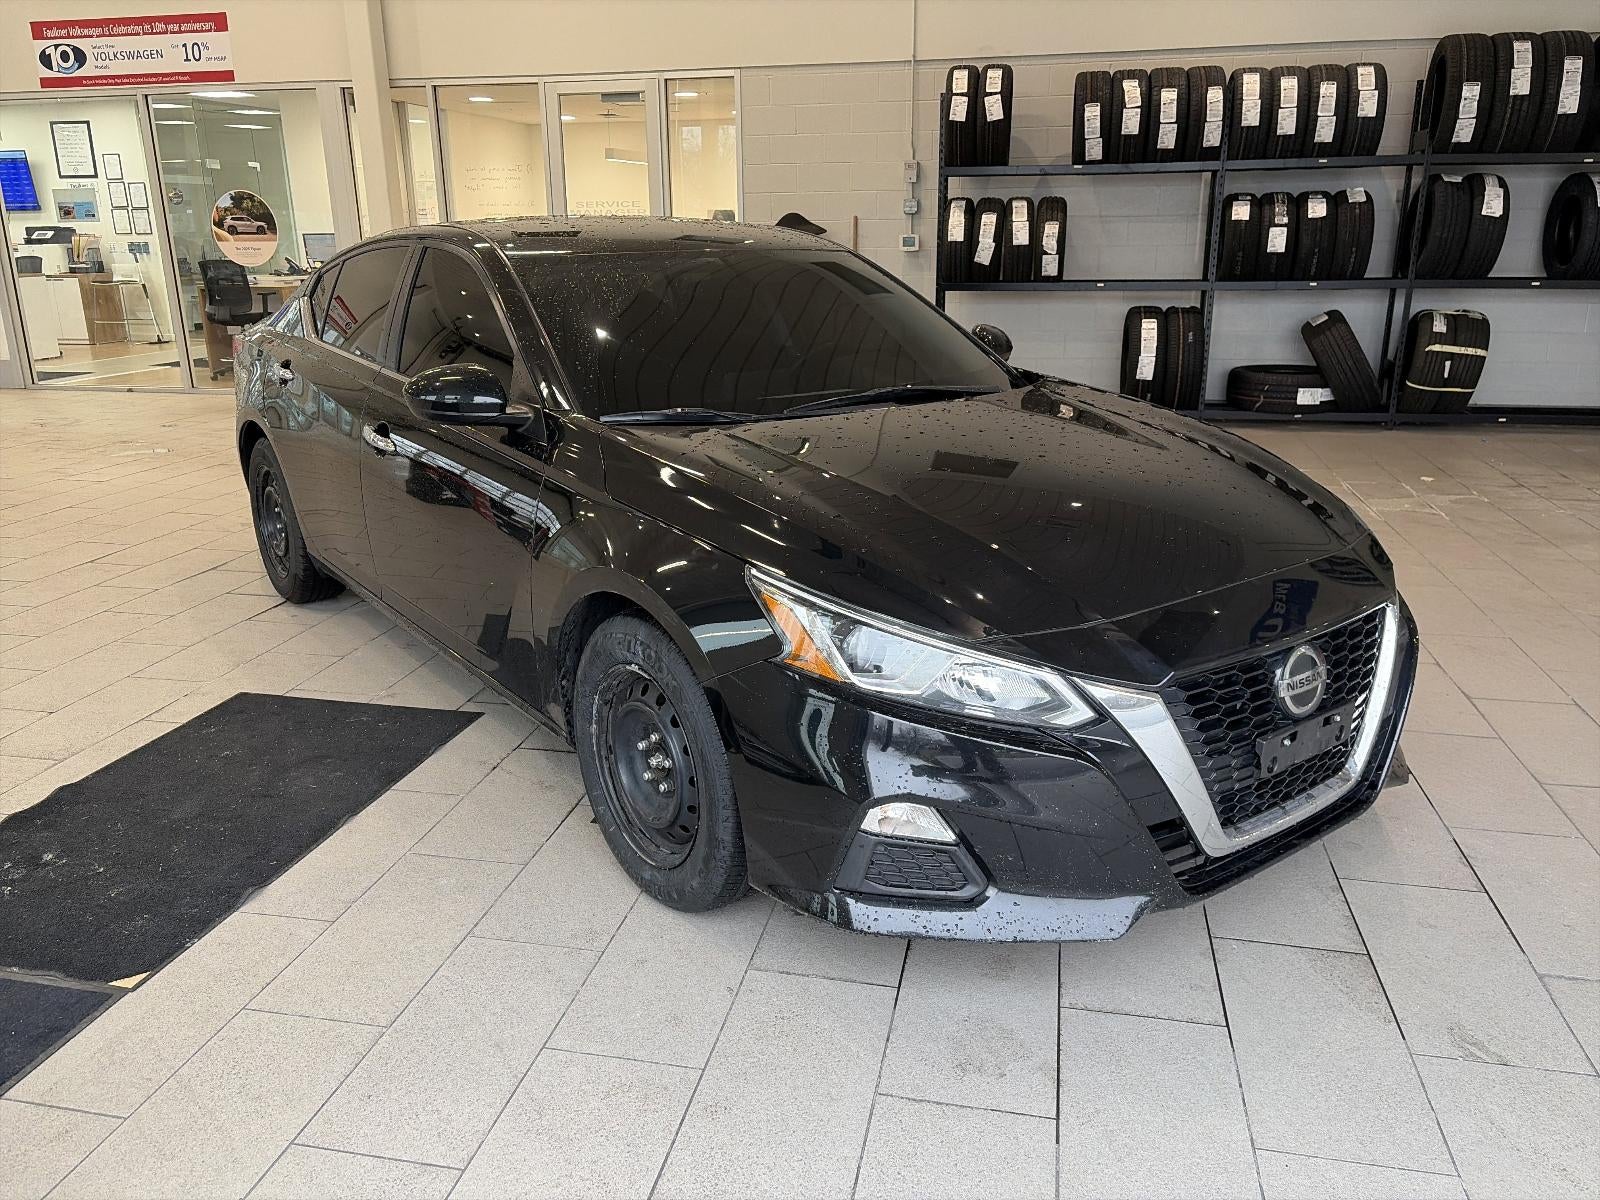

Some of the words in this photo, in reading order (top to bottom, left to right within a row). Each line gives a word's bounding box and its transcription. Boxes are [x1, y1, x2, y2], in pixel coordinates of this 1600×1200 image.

[43, 26, 67, 38] Faulkner
[68, 25, 103, 38] Volkswagen
[103, 24, 109, 35] is
[109, 22, 143, 36] Celebrating
[152, 21, 166, 33] 10th
[166, 23, 180, 34] year
[45, 45, 75, 72] 10
[92, 49, 164, 61] VOLKSWAGEN
[575, 200, 641, 208] SERVICE
[1286, 671, 1323, 692] NISSAN
